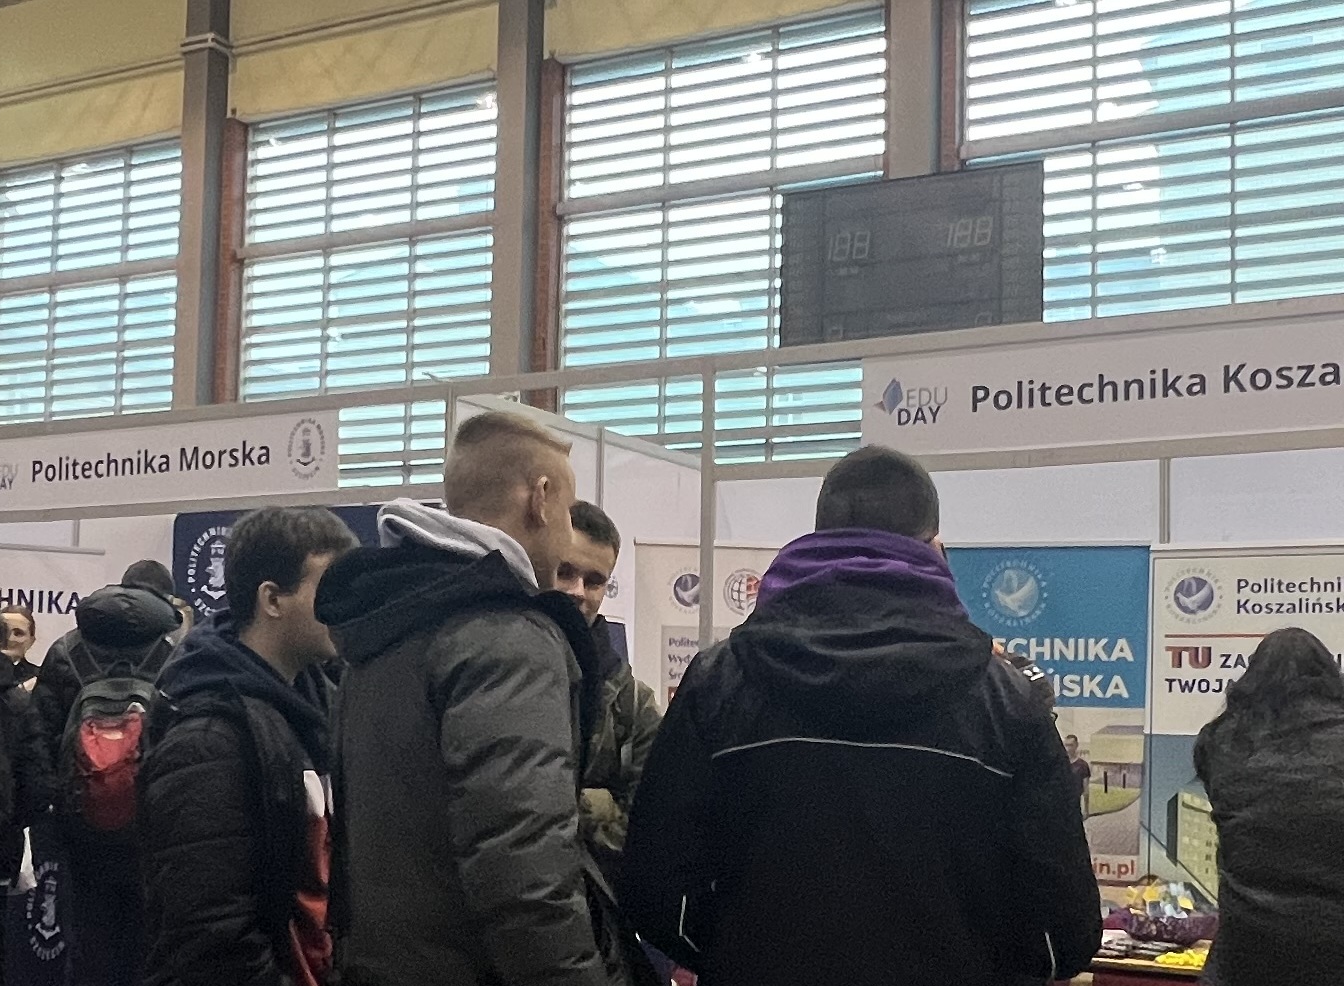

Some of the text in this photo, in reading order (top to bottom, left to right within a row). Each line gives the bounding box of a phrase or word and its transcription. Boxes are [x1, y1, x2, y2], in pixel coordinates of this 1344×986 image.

[906, 386, 948, 408] EDU
[971, 368, 1206, 413] Politechnika
[897, 406, 941, 426] DAY
[31, 449, 170, 483] Politechnika
[179, 440, 271, 472] Morska
[1164, 645, 1212, 669] TU
